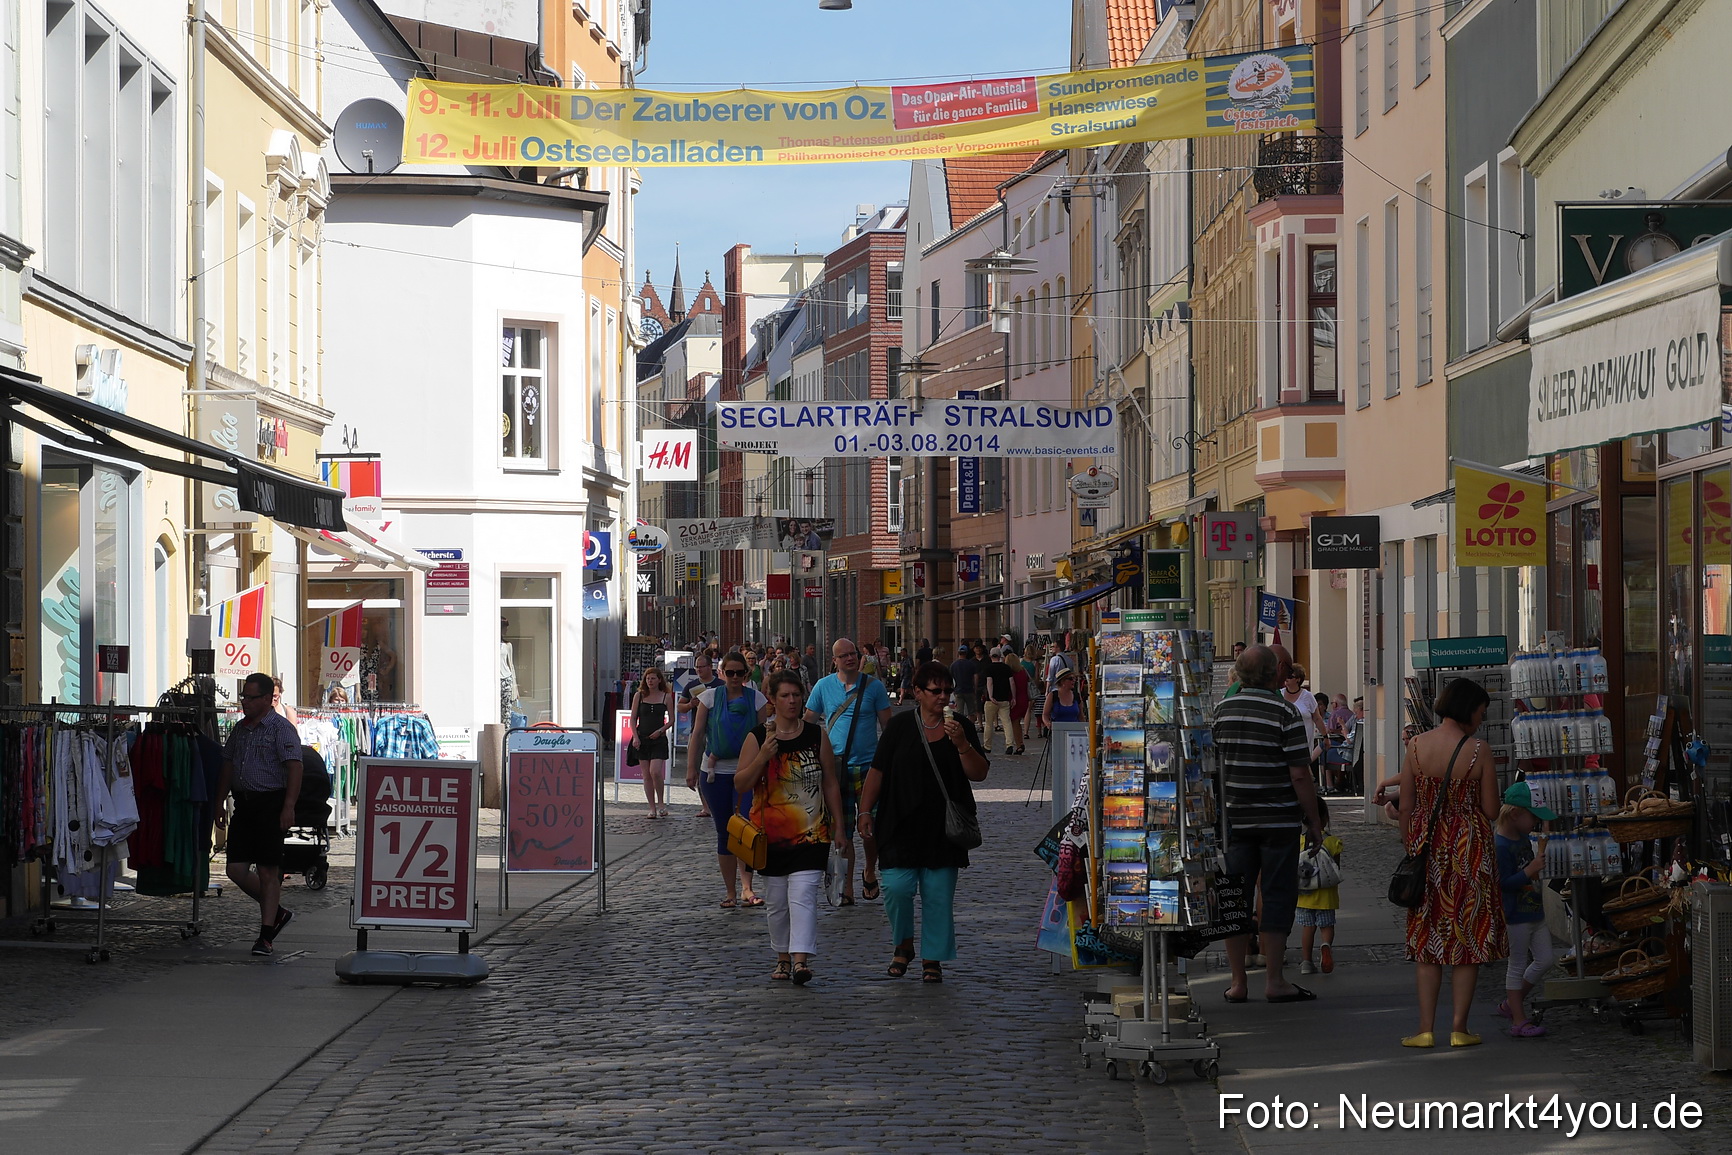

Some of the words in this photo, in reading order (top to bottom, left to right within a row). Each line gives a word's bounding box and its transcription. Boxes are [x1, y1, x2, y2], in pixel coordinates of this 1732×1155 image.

[902, 92, 923, 106] Das
[924, 79, 1027, 105] Open-Air-Musical
[1048, 68, 1199, 97] Sundpromenade
[467, 92, 500, 118] 11.
[507, 93, 562, 121] Juli
[570, 95, 626, 121] Der
[632, 96, 771, 122] Zauberer
[786, 101, 838, 121] von
[843, 94, 887, 121] Oz
[912, 109, 932, 124] für
[933, 106, 950, 121] die
[952, 106, 984, 121] ganze
[985, 100, 1028, 115] Familie
[1048, 95, 1158, 117] Hansawiese
[1223, 107, 1266, 121] Ostsee
[1050, 115, 1137, 136] Stralsund
[416, 133, 457, 160] 12.
[462, 135, 518, 160] Juli
[519, 136, 765, 164] Ostseeballaden
[778, 136, 830, 147] Thomas
[832, 133, 894, 146] Putensen
[896, 131, 921, 144] und
[923, 130, 946, 142] das
[778, 148, 887, 162] Philharmonische
[888, 144, 954, 157] Orchester
[955, 139, 1040, 152] Vorpommern
[1666, 332, 1709, 391] GOLD
[944, 405, 1113, 429] STRALSUND
[734, 441, 779, 449] PROJEKT
[1006, 445, 1115, 455] www.basic-events.de
[834, 434, 1000, 453] 01.-03.08.2014
[648, 440, 691, 471] H&M
[354, 502, 377, 513] family
[678, 520, 718, 538] 2014
[1465, 527, 1537, 547] LOTTO
[1317, 533, 1360, 546] GDM
[960, 560, 979, 573] P&C
[593, 590, 605, 601] O2
[1263, 599, 1277, 608] Soft
[1262, 607, 1276, 617] Eis
[532, 734, 573, 747] Douglas
[518, 757, 584, 775] FINAL
[374, 775, 459, 803] ALLE
[518, 776, 584, 797] SALE
[374, 803, 458, 815] SAISONARTIKEL
[517, 803, 584, 829] -50%
[379, 820, 450, 879] 1/2
[553, 855, 588, 868] Douglas
[370, 884, 456, 910] PREIS
